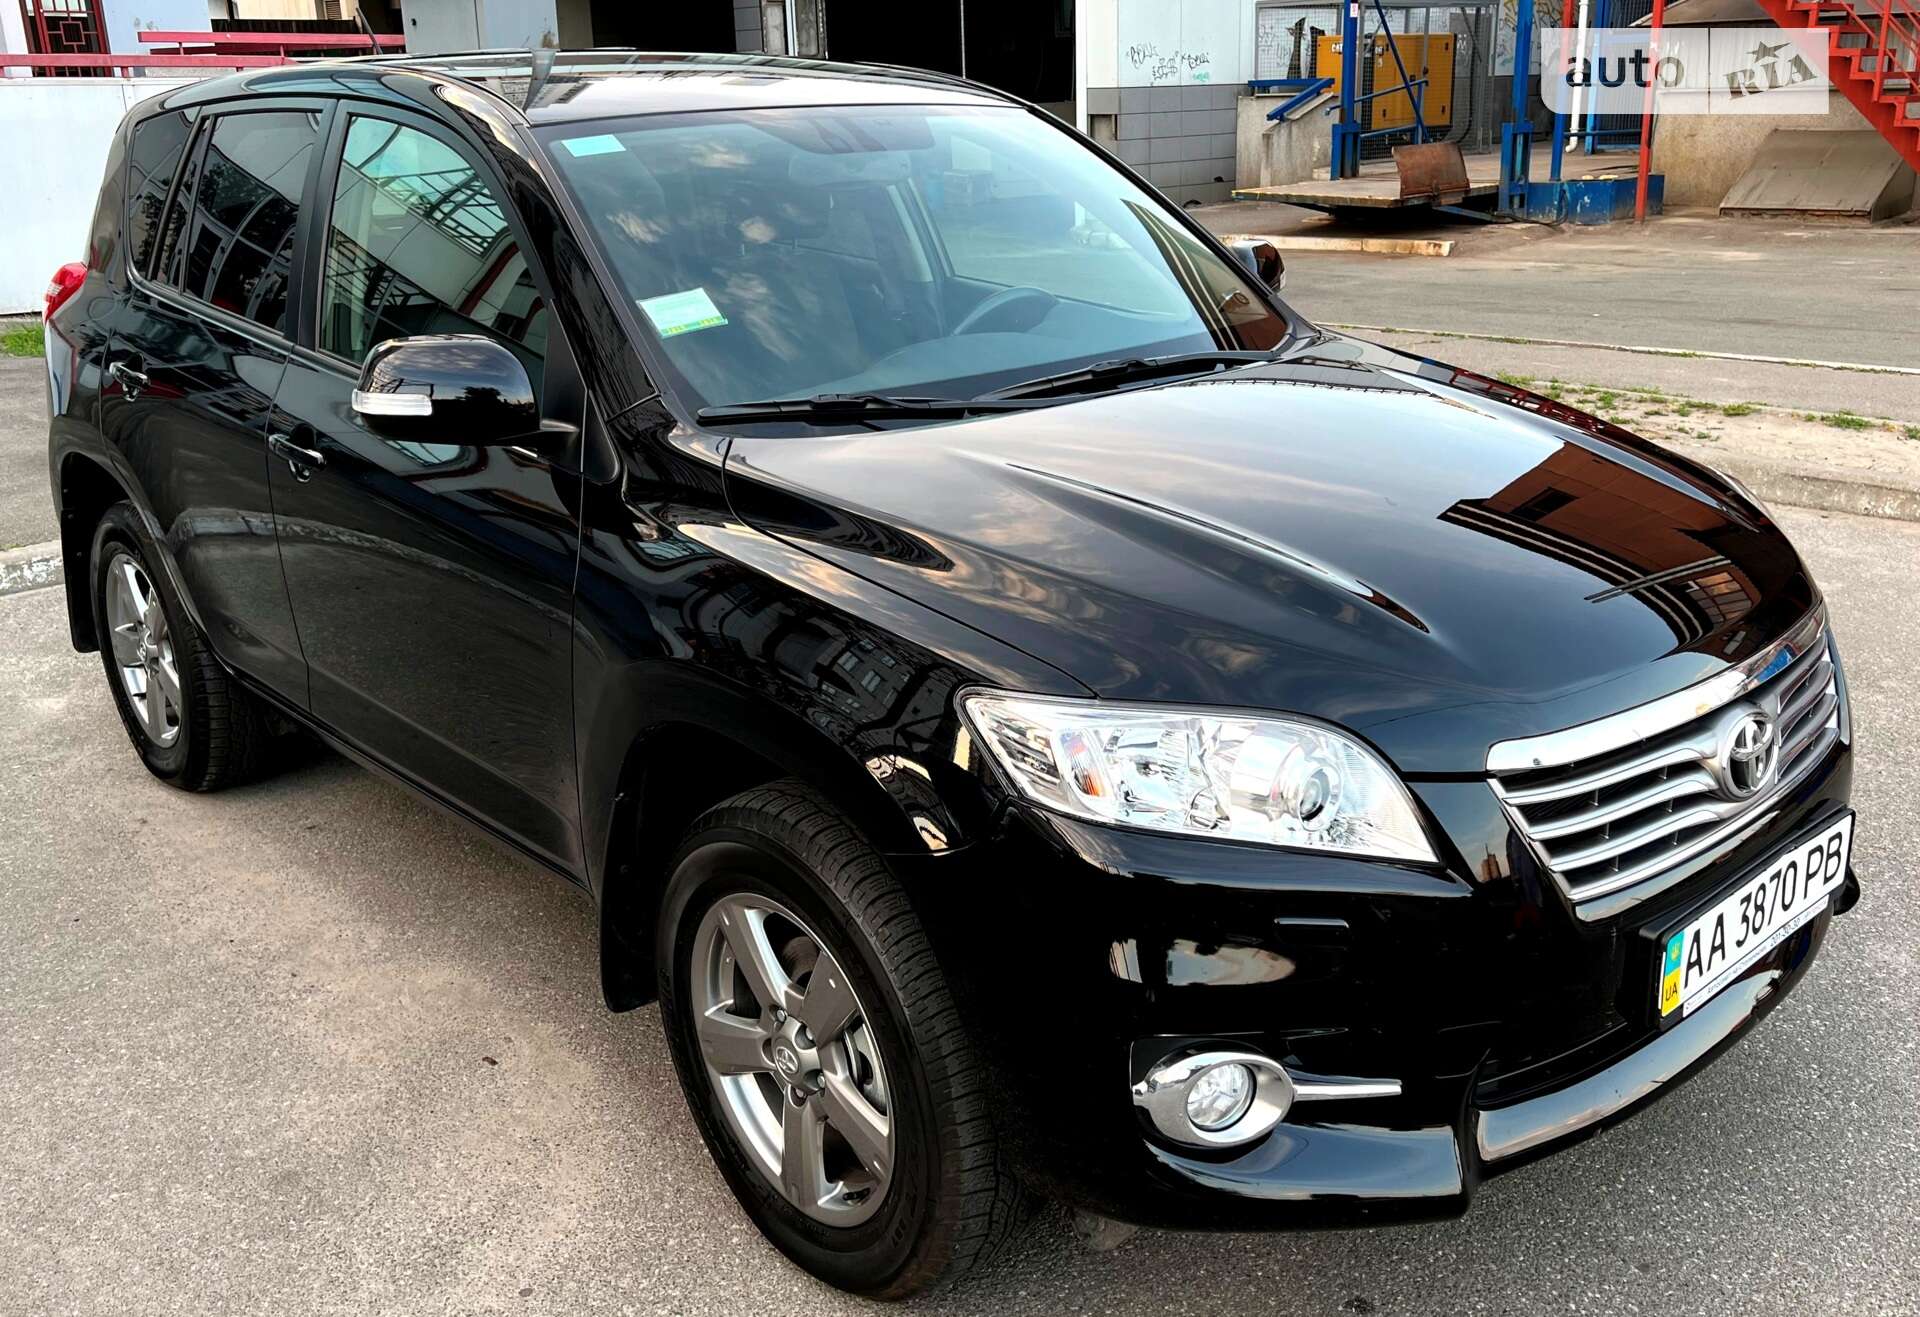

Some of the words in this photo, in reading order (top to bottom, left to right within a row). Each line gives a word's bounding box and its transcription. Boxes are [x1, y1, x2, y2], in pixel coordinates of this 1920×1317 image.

[1683, 912, 1726, 989] AA
[1735, 860, 1798, 949] 3870
[1803, 831, 1843, 900] PB
[1665, 982, 1678, 1002] UA
